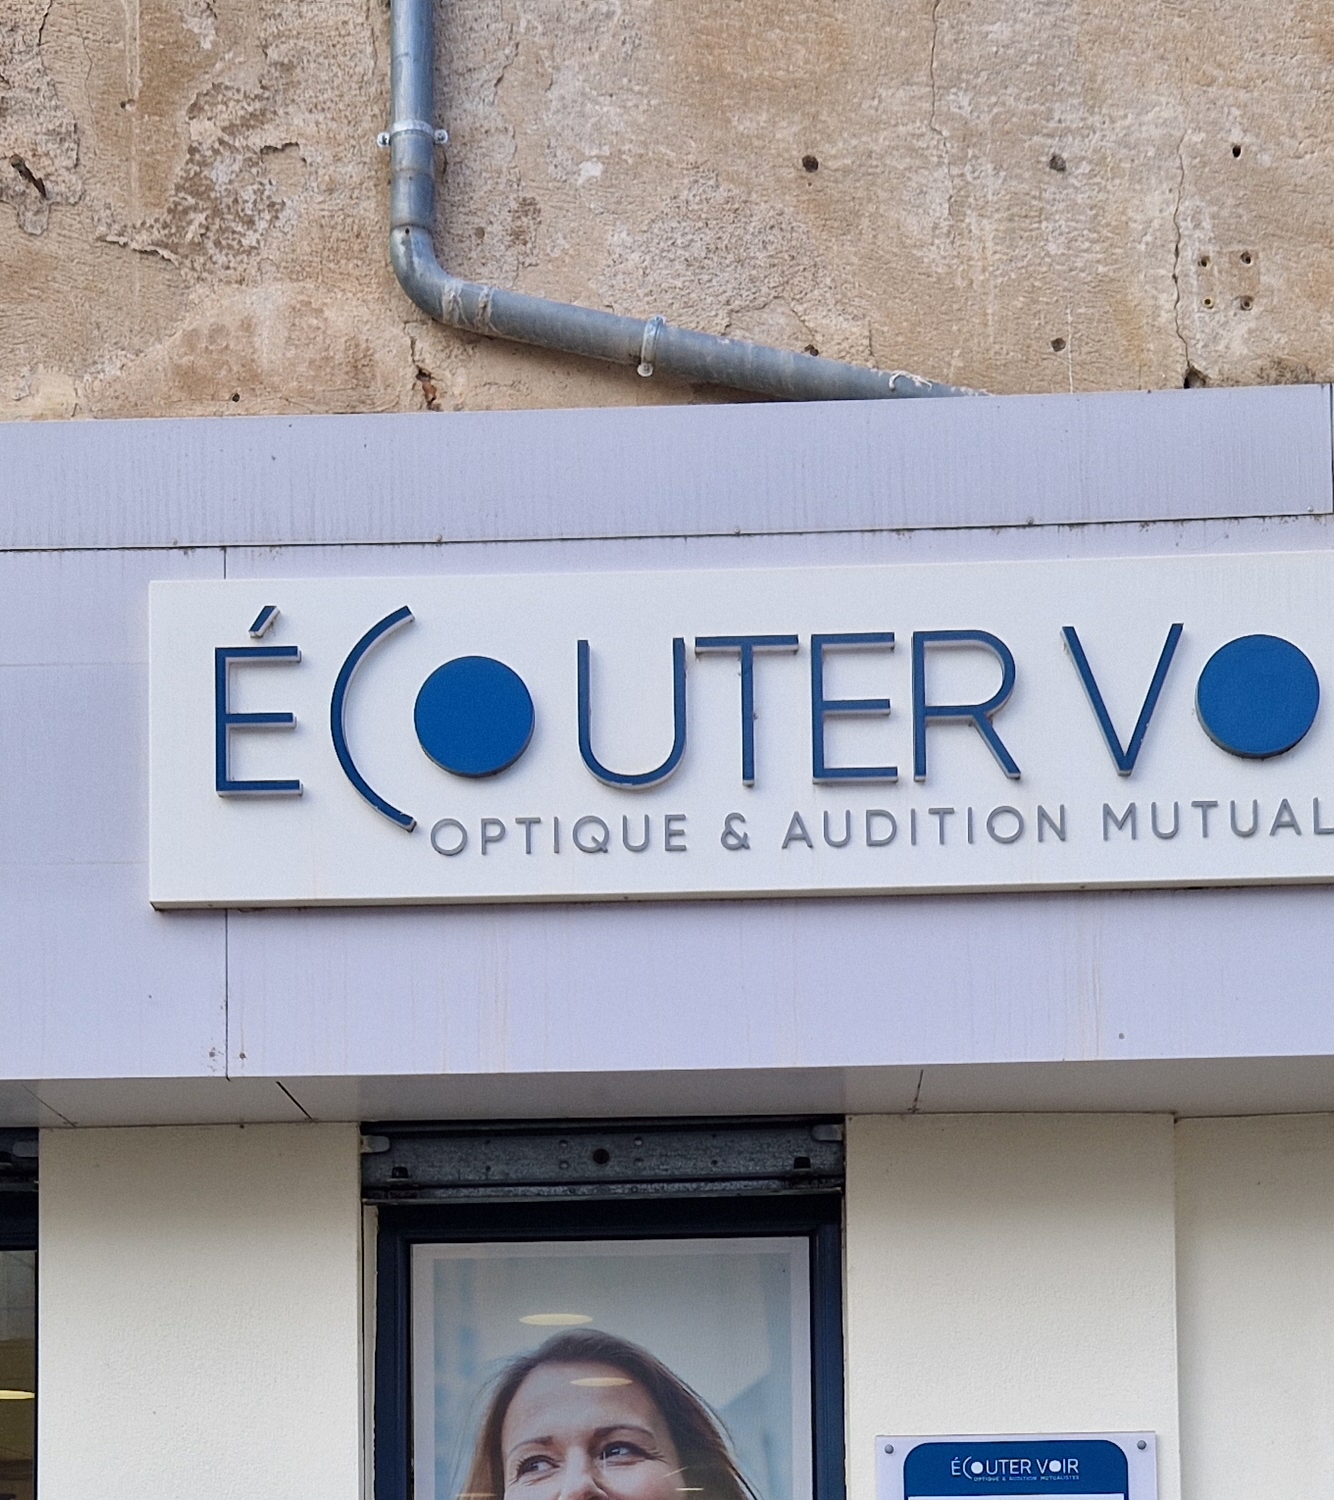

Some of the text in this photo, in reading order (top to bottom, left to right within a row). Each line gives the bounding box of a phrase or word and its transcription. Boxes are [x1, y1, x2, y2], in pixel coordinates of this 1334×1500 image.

[213, 604, 1024, 832] ÉCOUTER
[430, 809, 689, 859] OPTIQUE
[719, 812, 751, 852] &
[782, 803, 1068, 850] AUDITION
[951, 1456, 1079, 1480] ÉCOUTER VOIR
